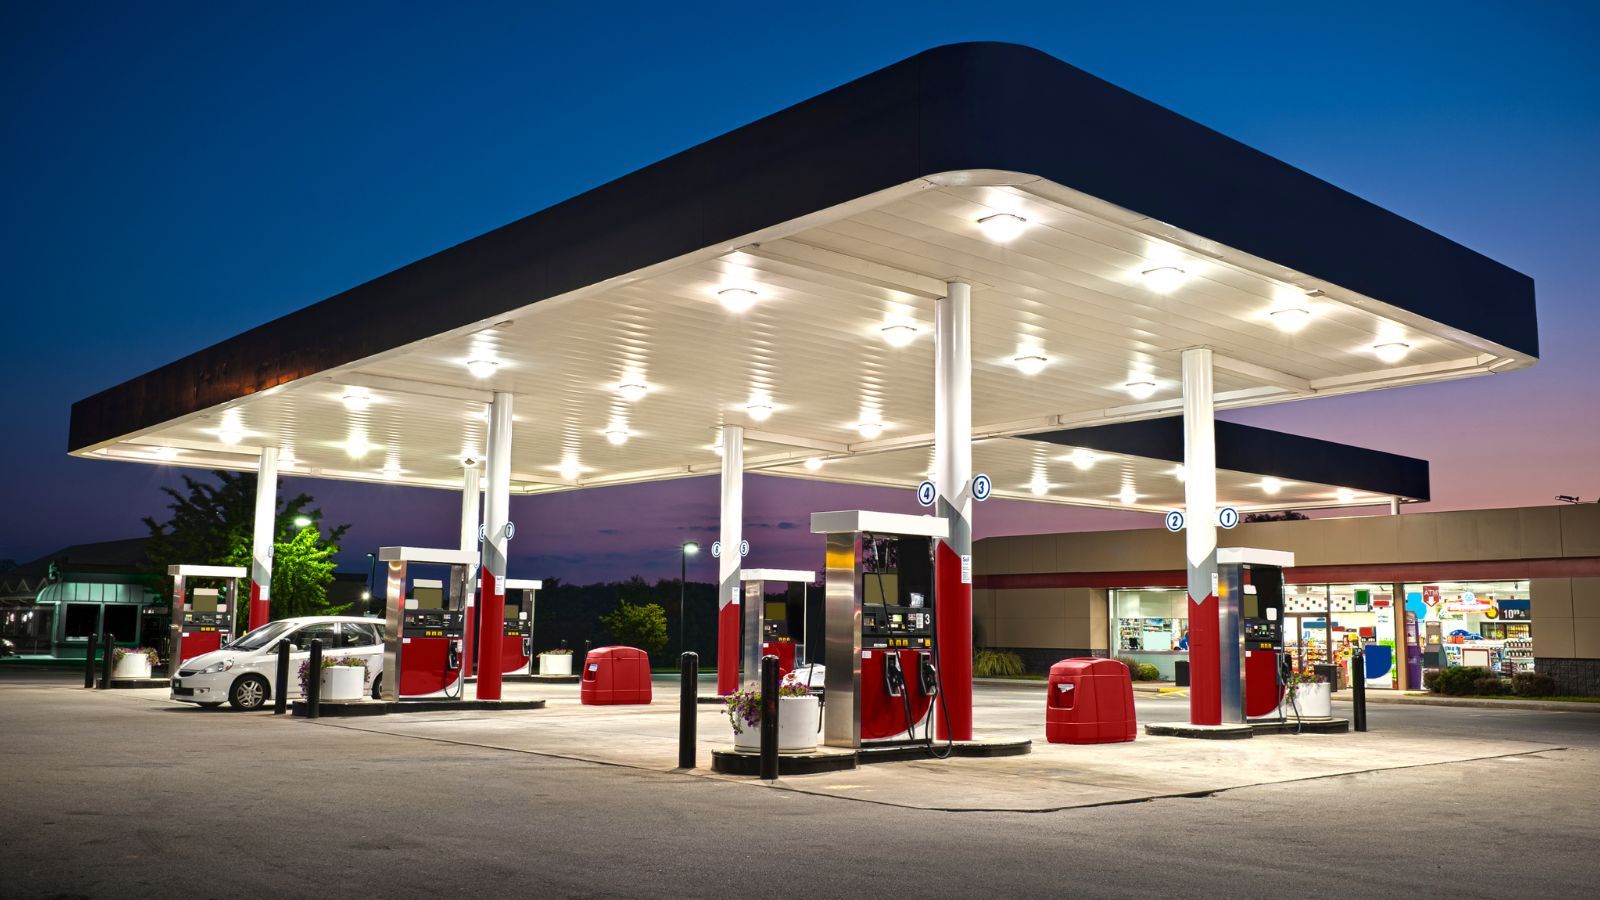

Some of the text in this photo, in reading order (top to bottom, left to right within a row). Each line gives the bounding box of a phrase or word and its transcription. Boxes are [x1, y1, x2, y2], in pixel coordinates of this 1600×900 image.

[924, 487, 930, 499] 4
[978, 481, 985, 494] 3
[1172, 515, 1179, 527] 2
[1226, 512, 1231, 524] 1
[458, 614, 464, 622] 7
[924, 613, 931, 625] 3
